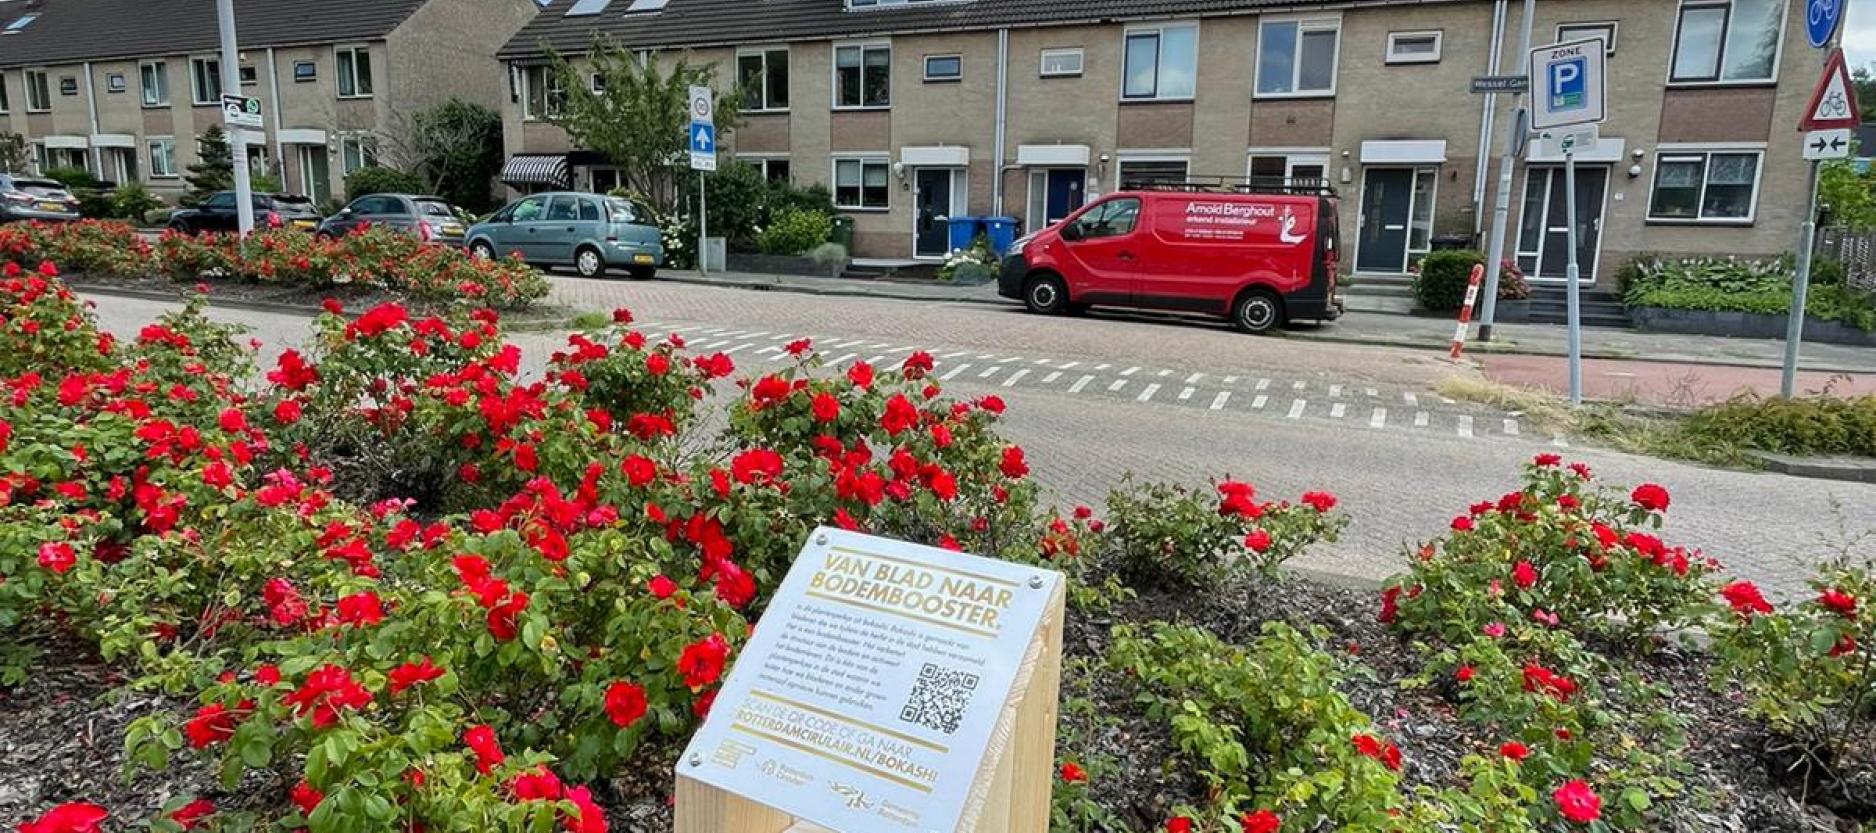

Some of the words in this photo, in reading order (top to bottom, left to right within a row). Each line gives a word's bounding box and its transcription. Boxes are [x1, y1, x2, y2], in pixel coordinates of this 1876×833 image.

[1552, 47, 1582, 59] ZONE
[1475, 79, 1506, 88] Wessel
[1554, 63, 1580, 94] P
[1185, 202, 1222, 215] Arnold
[1223, 203, 1275, 217] Berghout
[824, 554, 872, 577] VAN
[875, 564, 934, 589] BLAD
[939, 576, 1014, 609] NAAR
[811, 571, 1002, 629] BODEMBOOSTER.
[804, 715, 839, 734] CODE
[855, 730, 878, 746] GA
[876, 738, 913, 758] NAAR
